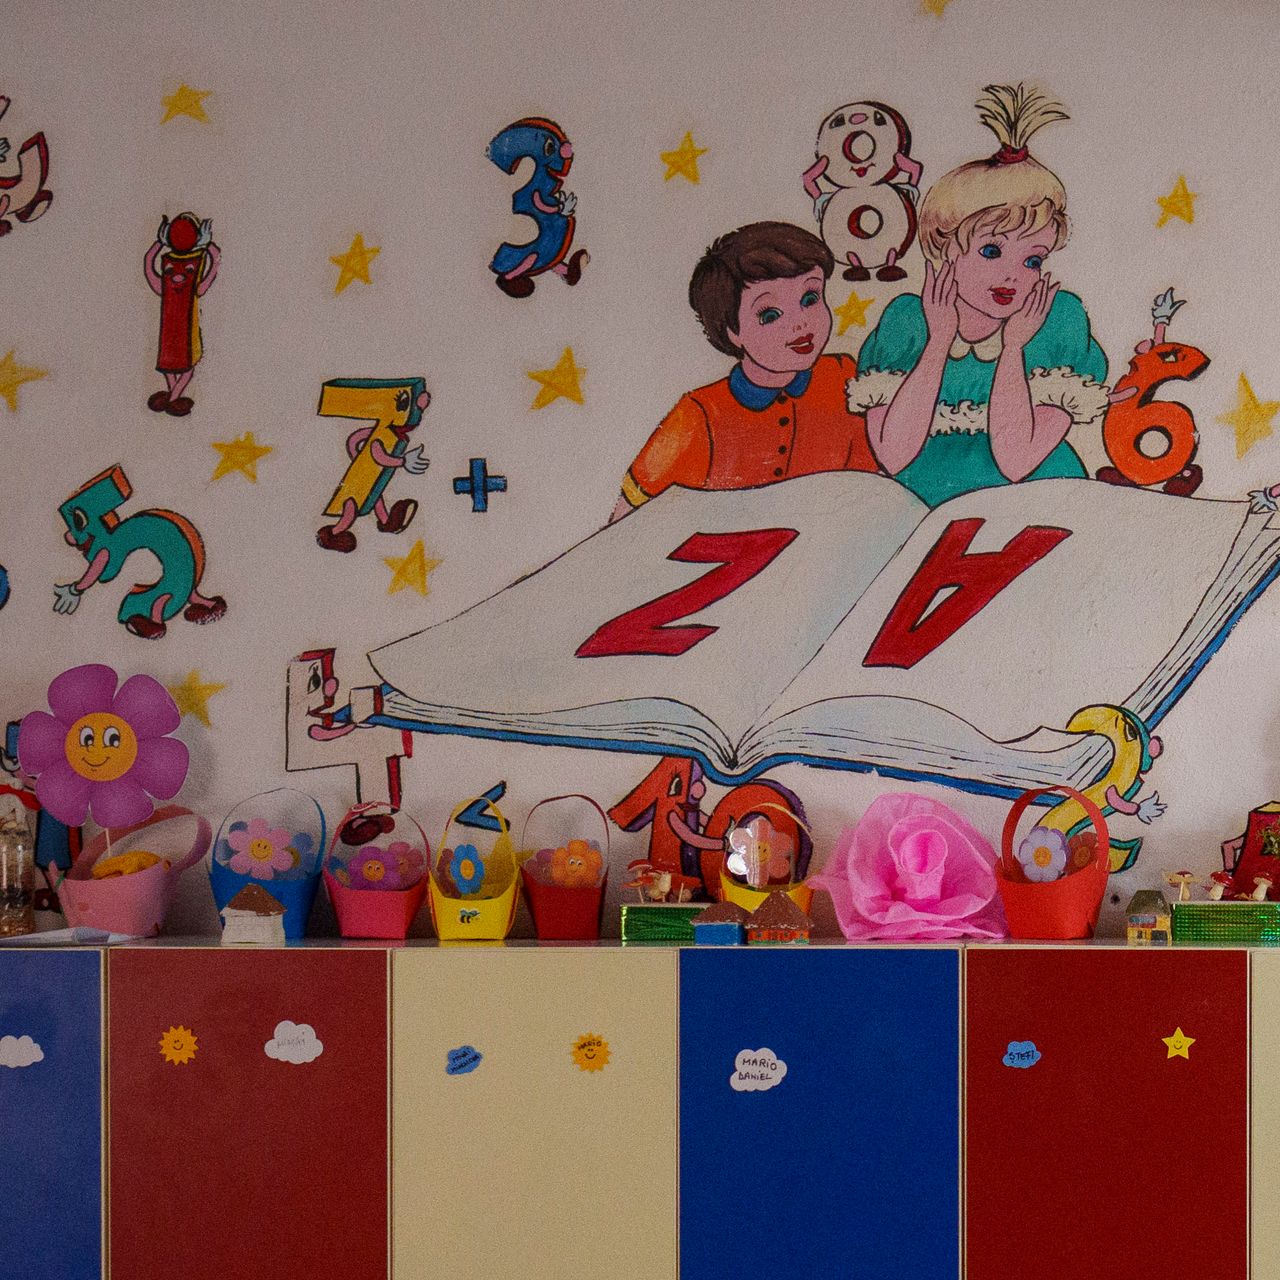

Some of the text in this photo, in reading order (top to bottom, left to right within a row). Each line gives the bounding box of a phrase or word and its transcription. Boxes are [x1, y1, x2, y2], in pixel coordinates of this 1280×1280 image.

[485, 117, 577, 277] 3
[815, 101, 918, 268] 8
[316, 377, 428, 516] 7
[1102, 342, 1212, 486] 6
[59, 464, 206, 623] 5
